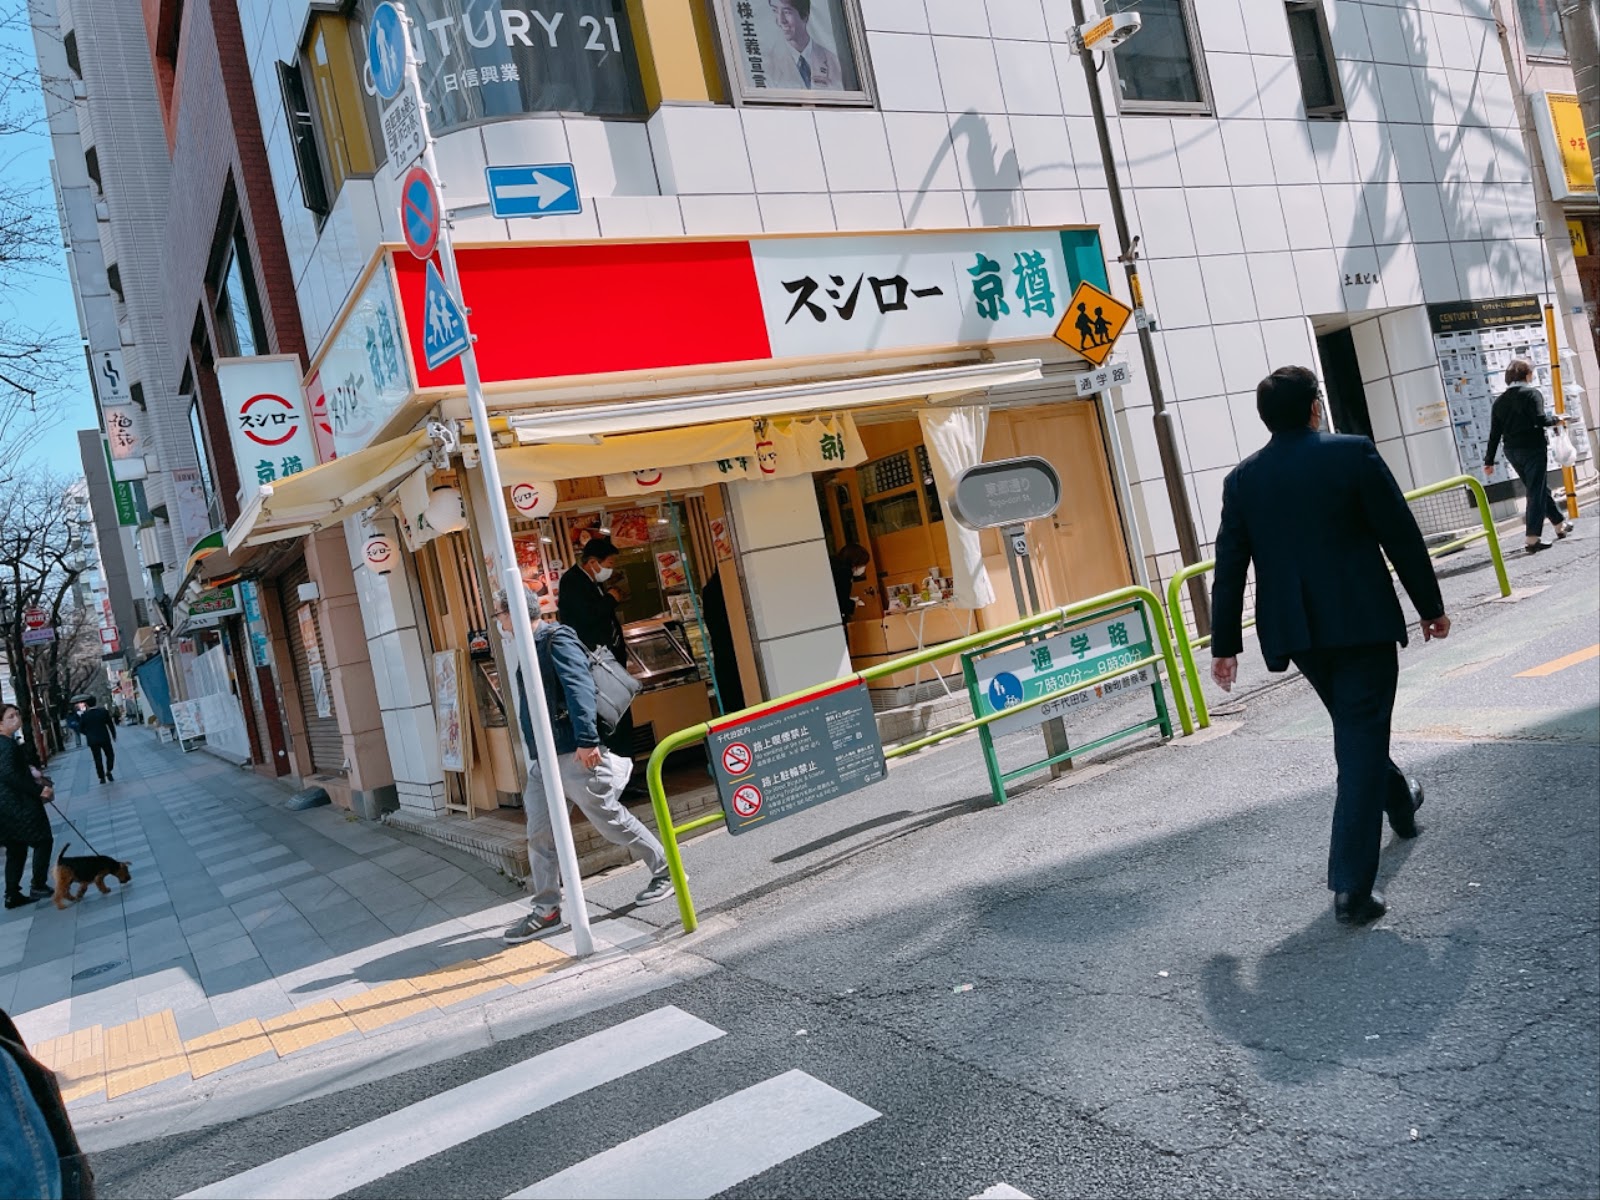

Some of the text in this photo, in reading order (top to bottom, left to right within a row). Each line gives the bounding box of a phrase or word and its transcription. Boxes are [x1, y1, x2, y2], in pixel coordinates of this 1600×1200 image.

[579, 15, 621, 52] 21
[443, 63, 520, 92] 日信興業
[781, 271, 943, 325] スシロー
[967, 250, 1056, 321] 京樽
[1440, 310, 1470, 323] CENTURY
[1080, 367, 1126, 391] 通学路
[238, 412, 300, 430] スシロー
[513, 491, 539, 503] スシロー
[367, 546, 392, 557] スシロー
[1030, 620, 1130, 674] 通学路
[1051, 691, 1090, 712] 千代田区
